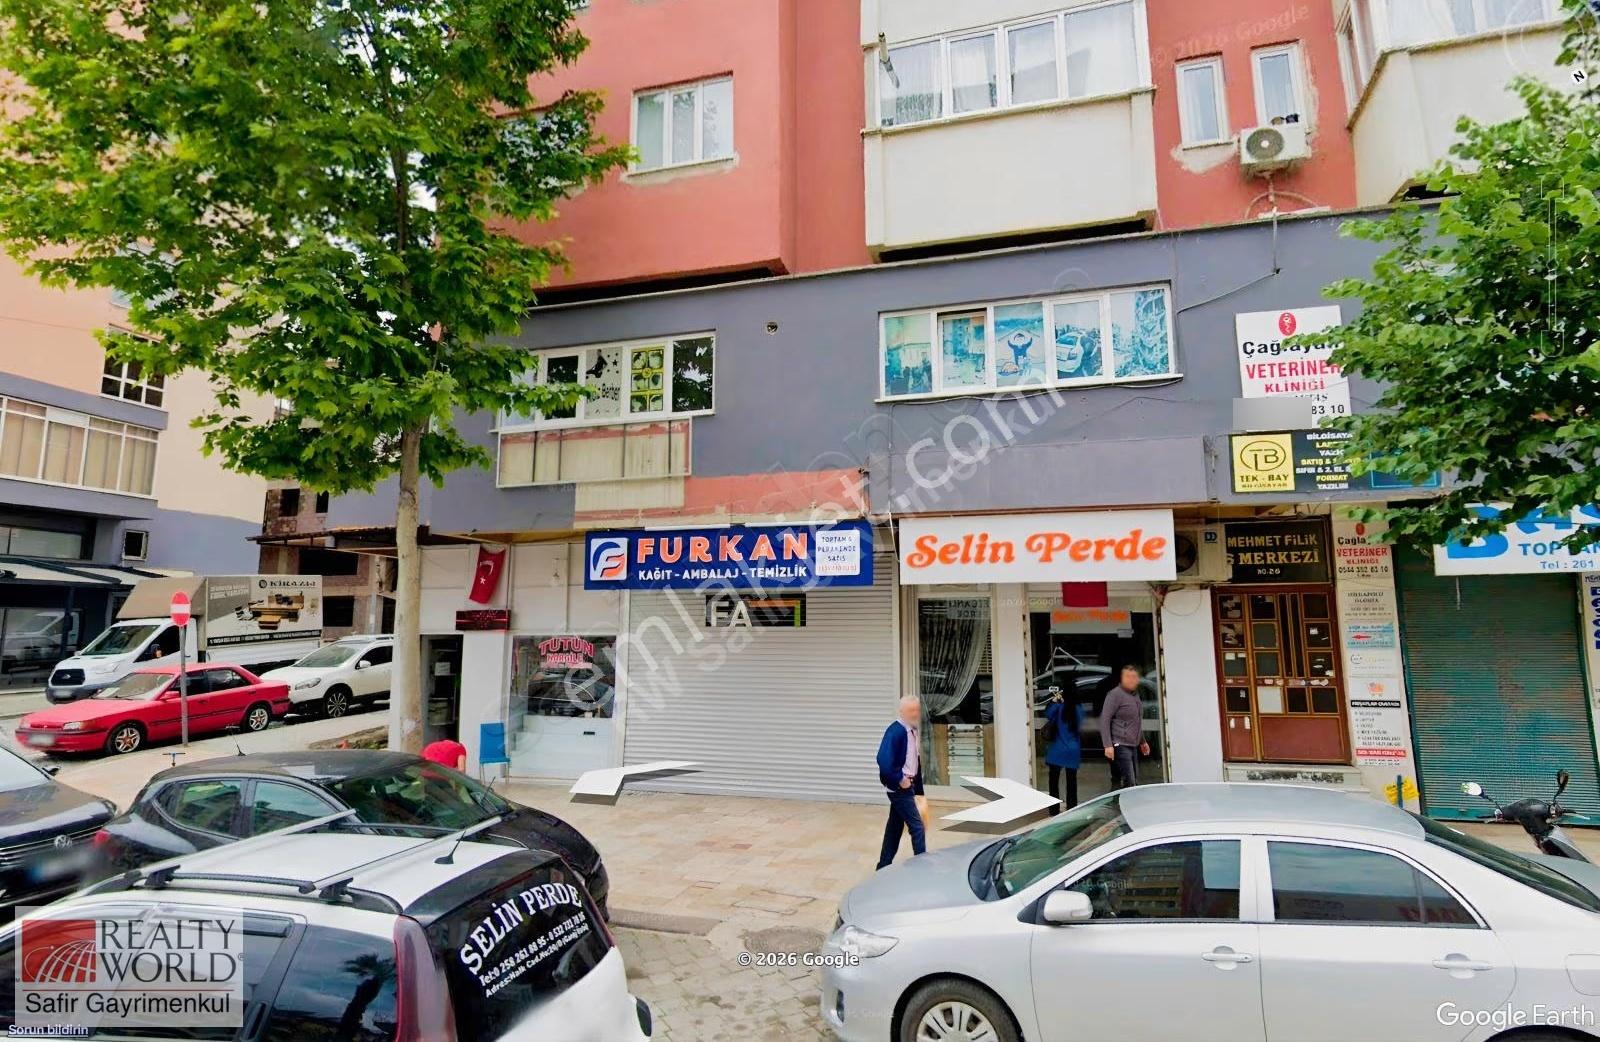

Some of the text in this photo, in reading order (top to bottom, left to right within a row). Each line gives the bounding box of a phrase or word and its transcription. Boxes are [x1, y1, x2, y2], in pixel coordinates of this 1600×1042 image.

[1331, 404, 1345, 413] 10
[637, 533, 808, 564] FURKAN
[907, 529, 1167, 568] Selin Perde
[1227, 536, 1281, 547] MEHMET
[1238, 549, 1320, 565] MERKEZİ
[1540, 560, 1559, 569] Tel
[638, 567, 672, 580] KAĞIT
[682, 569, 740, 580] AMBALAJ
[749, 565, 807, 579] TEMİZLİK
[460, 882, 583, 975] SELİN PERDE
